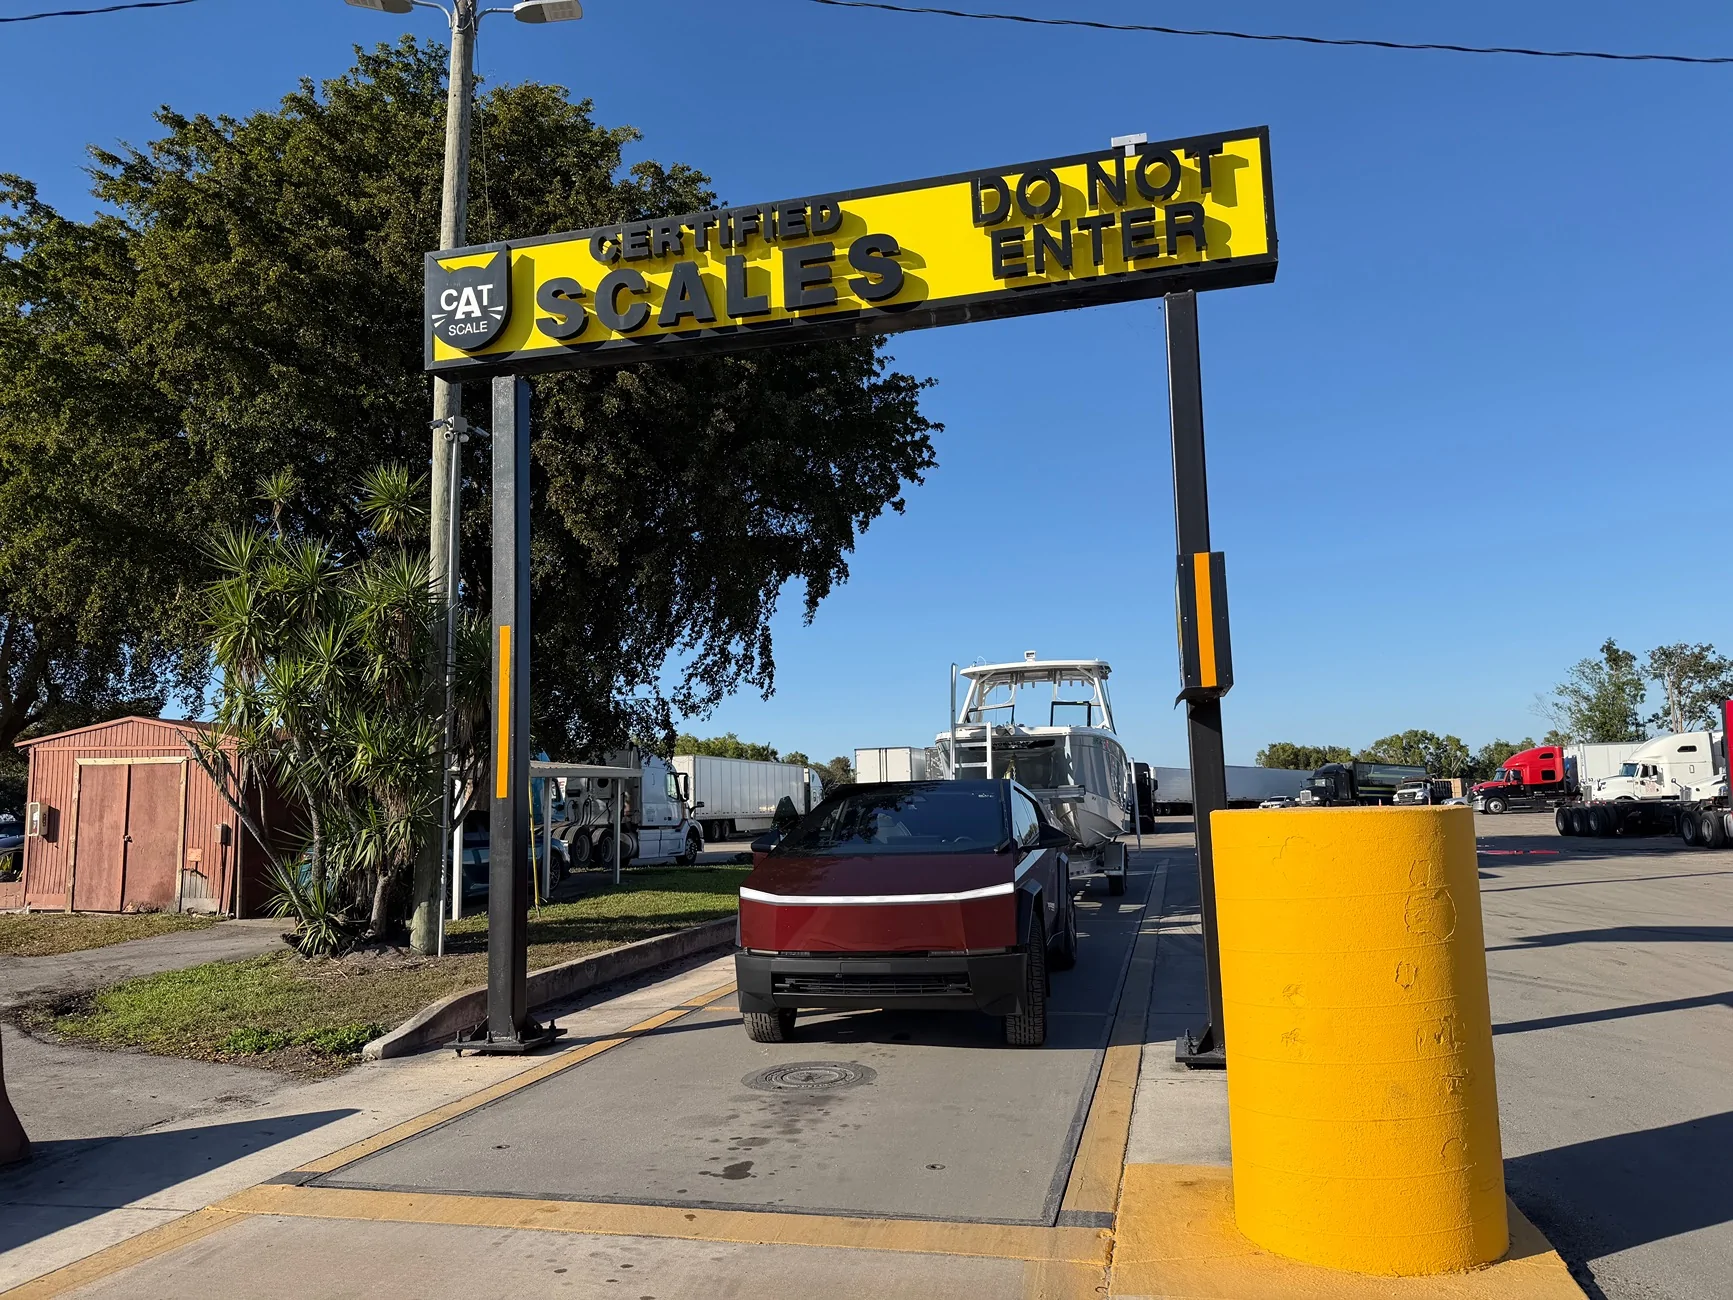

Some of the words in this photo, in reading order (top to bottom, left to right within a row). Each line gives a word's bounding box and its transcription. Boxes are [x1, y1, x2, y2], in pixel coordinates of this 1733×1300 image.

[971, 168, 1061, 228] DO
[1086, 146, 1223, 211] NOT
[589, 198, 843, 264] CERTIFIED
[991, 201, 1208, 280] ENTER
[440, 284, 493, 320] CAT
[535, 233, 905, 340] SCALES
[448, 321, 488, 336] SCALE
